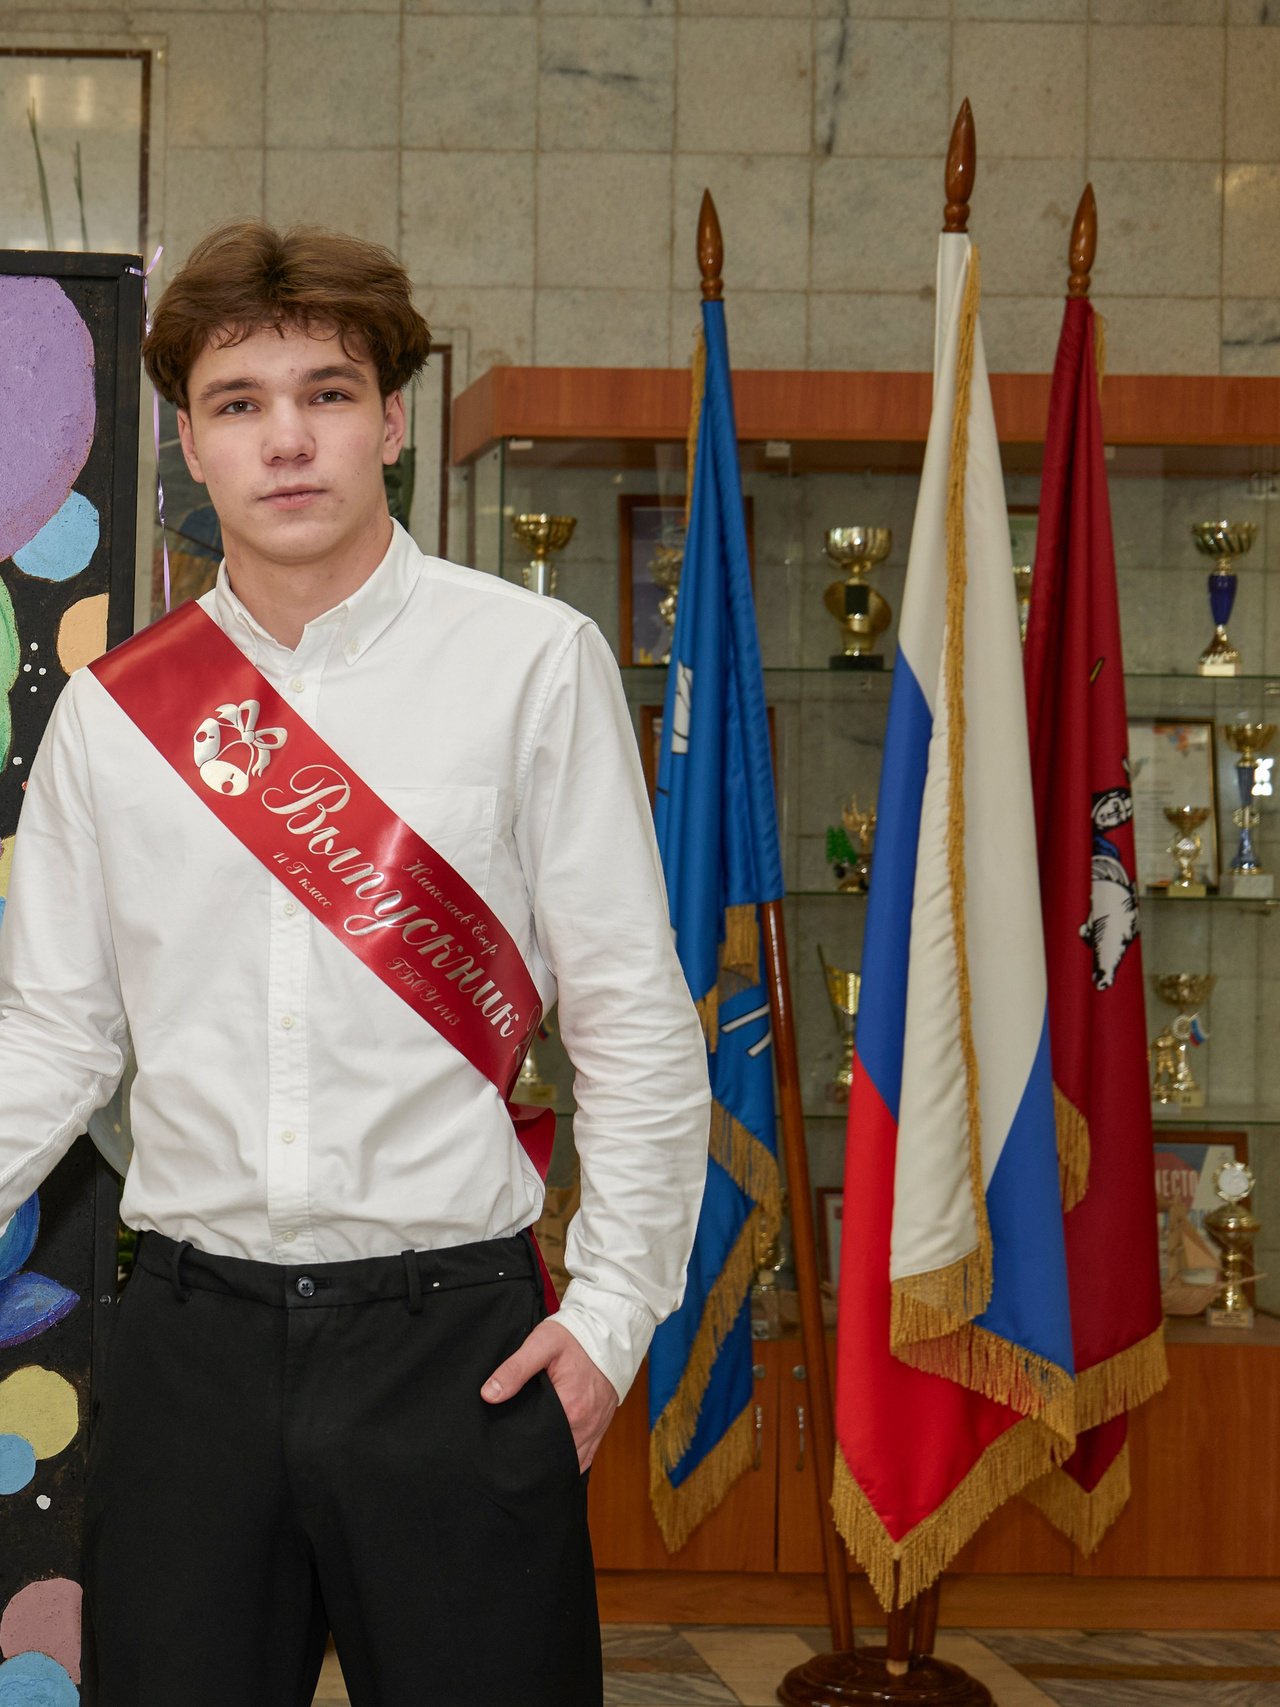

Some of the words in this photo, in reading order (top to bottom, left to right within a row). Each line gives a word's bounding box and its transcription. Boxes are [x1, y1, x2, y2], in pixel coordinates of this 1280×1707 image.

[261, 764, 520, 1038] Выпускник
[273, 851, 289, 864] 11
[298, 878, 332, 909] класс
[401, 858, 475, 925] Николаев
[472, 920, 499, 955] Егор
